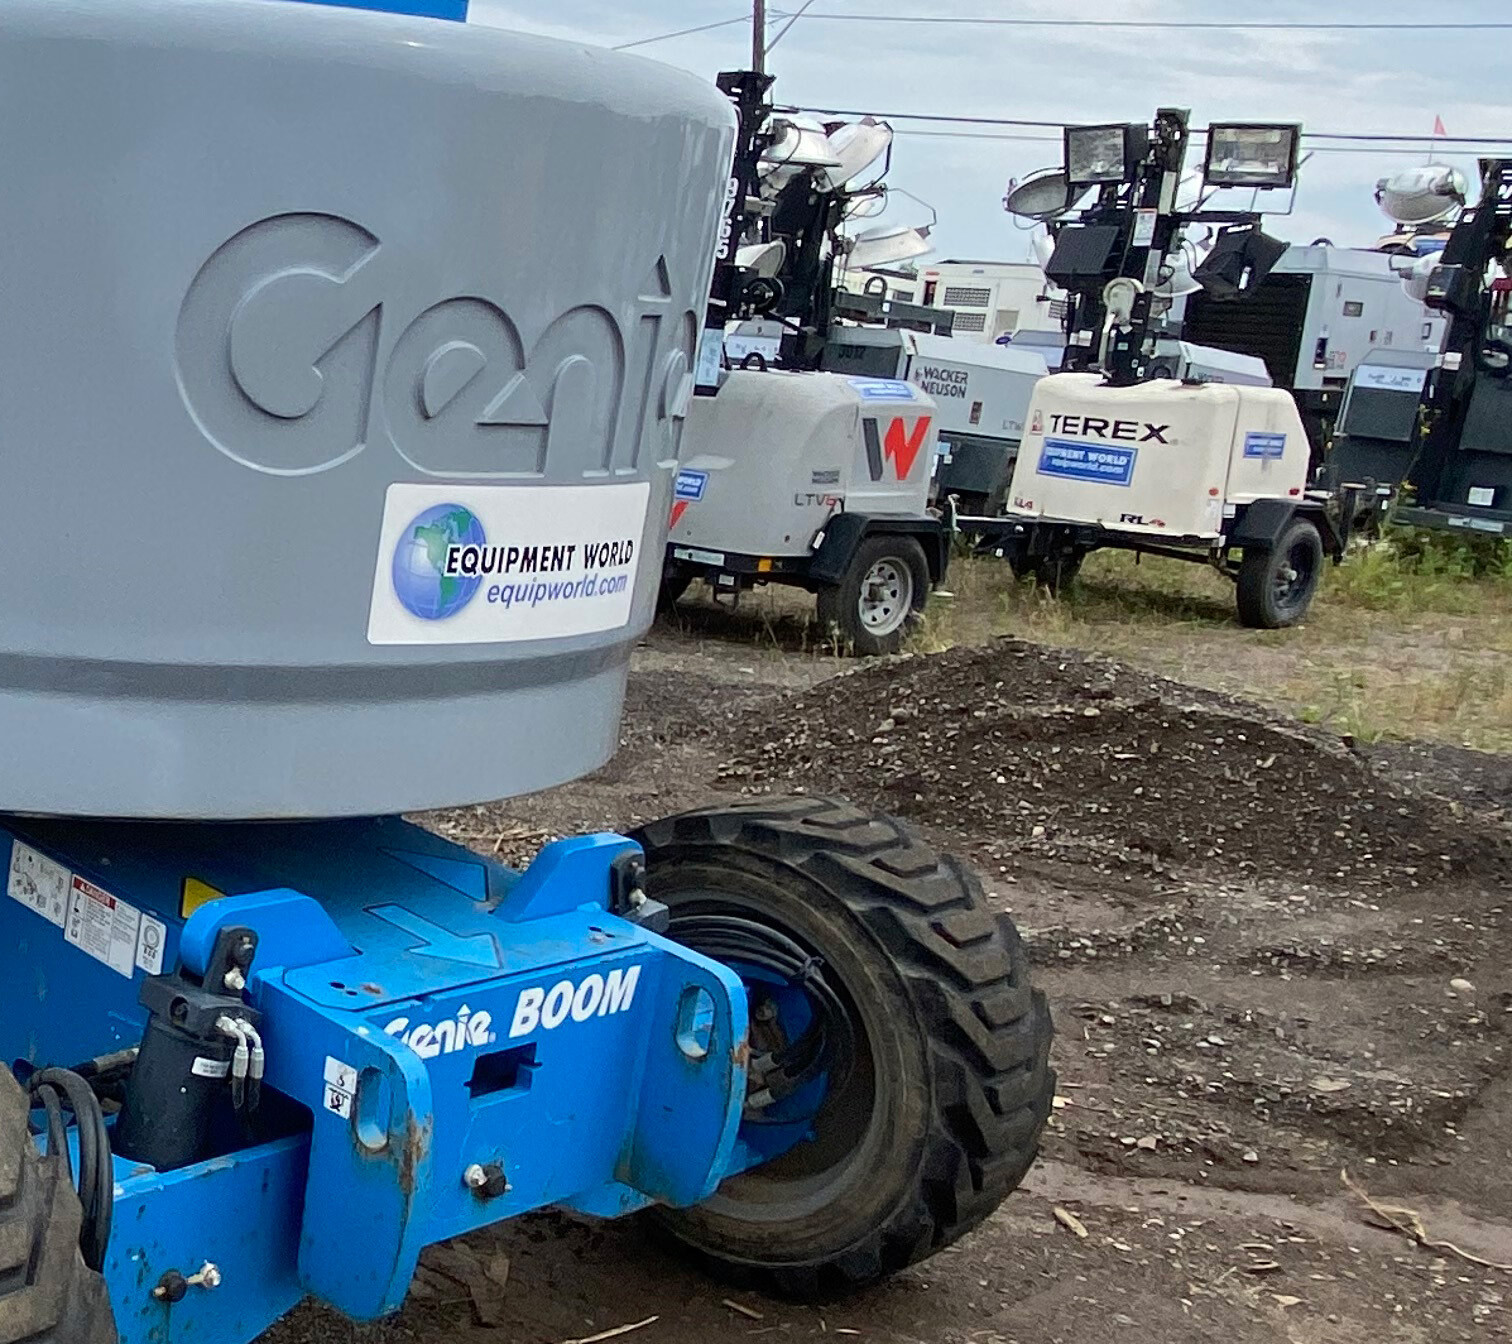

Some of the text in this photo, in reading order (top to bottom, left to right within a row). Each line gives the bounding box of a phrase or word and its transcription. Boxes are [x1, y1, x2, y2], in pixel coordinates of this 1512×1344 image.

[920, 380, 967, 399] NEUSON
[924, 366, 968, 384] WACKER
[1050, 414, 1170, 444] TEREX
[1087, 451, 1127, 465] WORLD
[445, 540, 634, 575] EQUIPMENT WORLD
[487, 573, 628, 610] equipworld.com
[383, 964, 642, 1060] Genie BOOM
